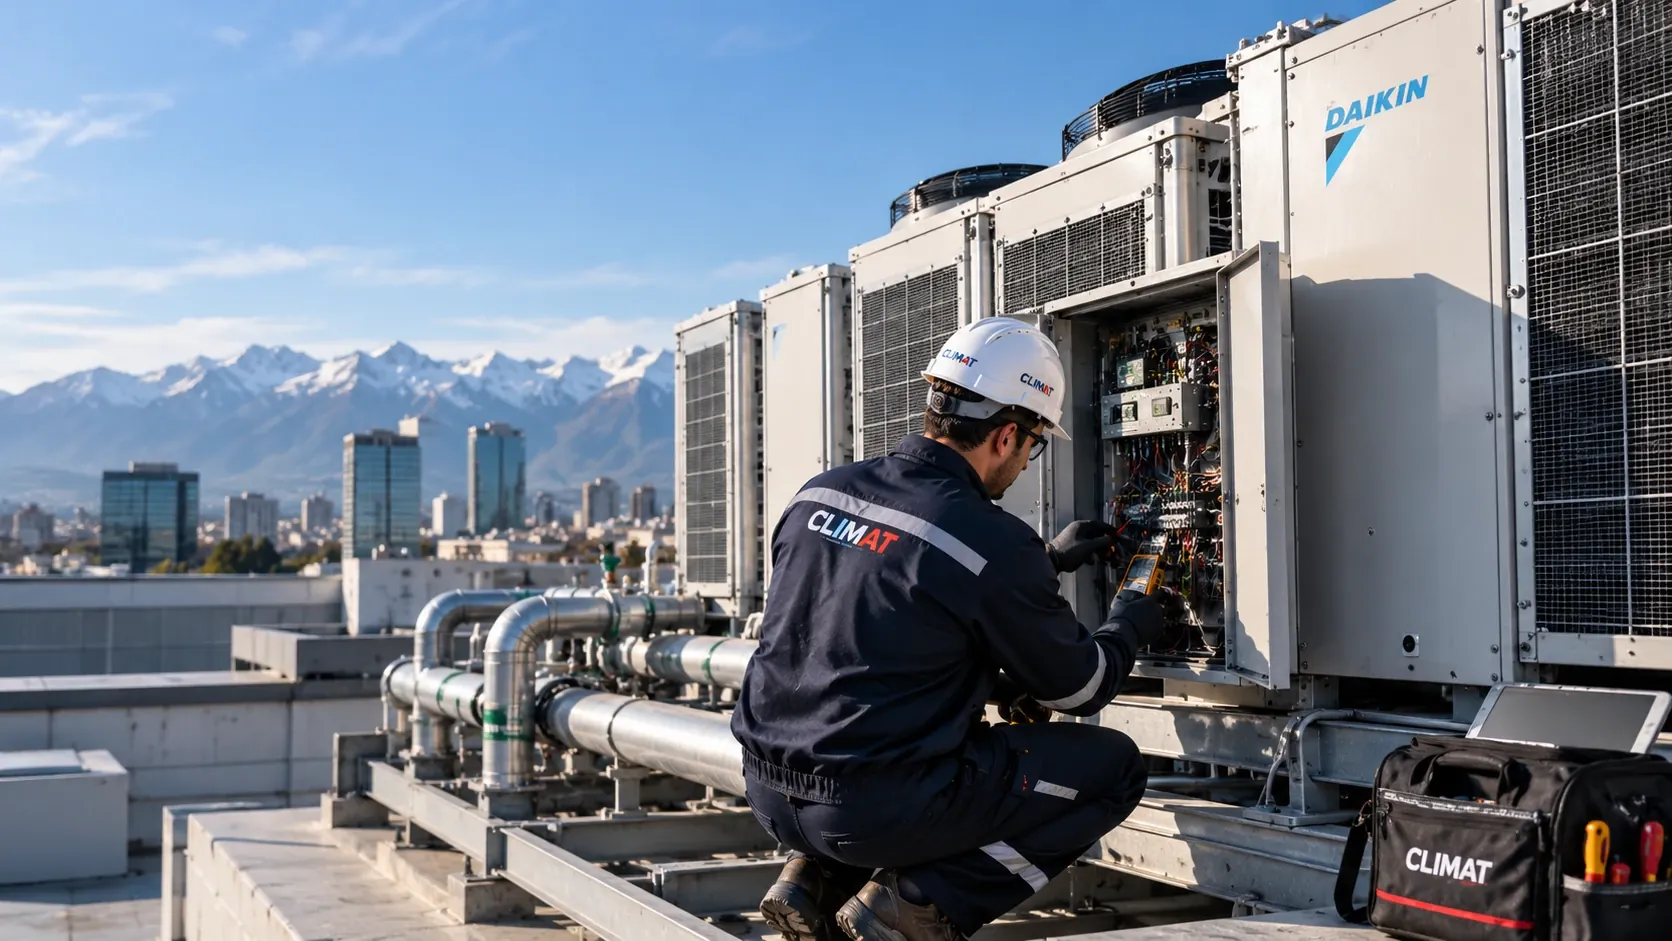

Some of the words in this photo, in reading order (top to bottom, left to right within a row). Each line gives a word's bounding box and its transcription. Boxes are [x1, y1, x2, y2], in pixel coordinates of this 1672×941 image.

[1325, 74, 1428, 132] DAIKIN
[942, 349, 978, 367] CLIMAT
[1020, 373, 1054, 396] CLIMAT
[807, 509, 899, 554] CLIMAT
[1406, 847, 1493, 884] CLIMAT
